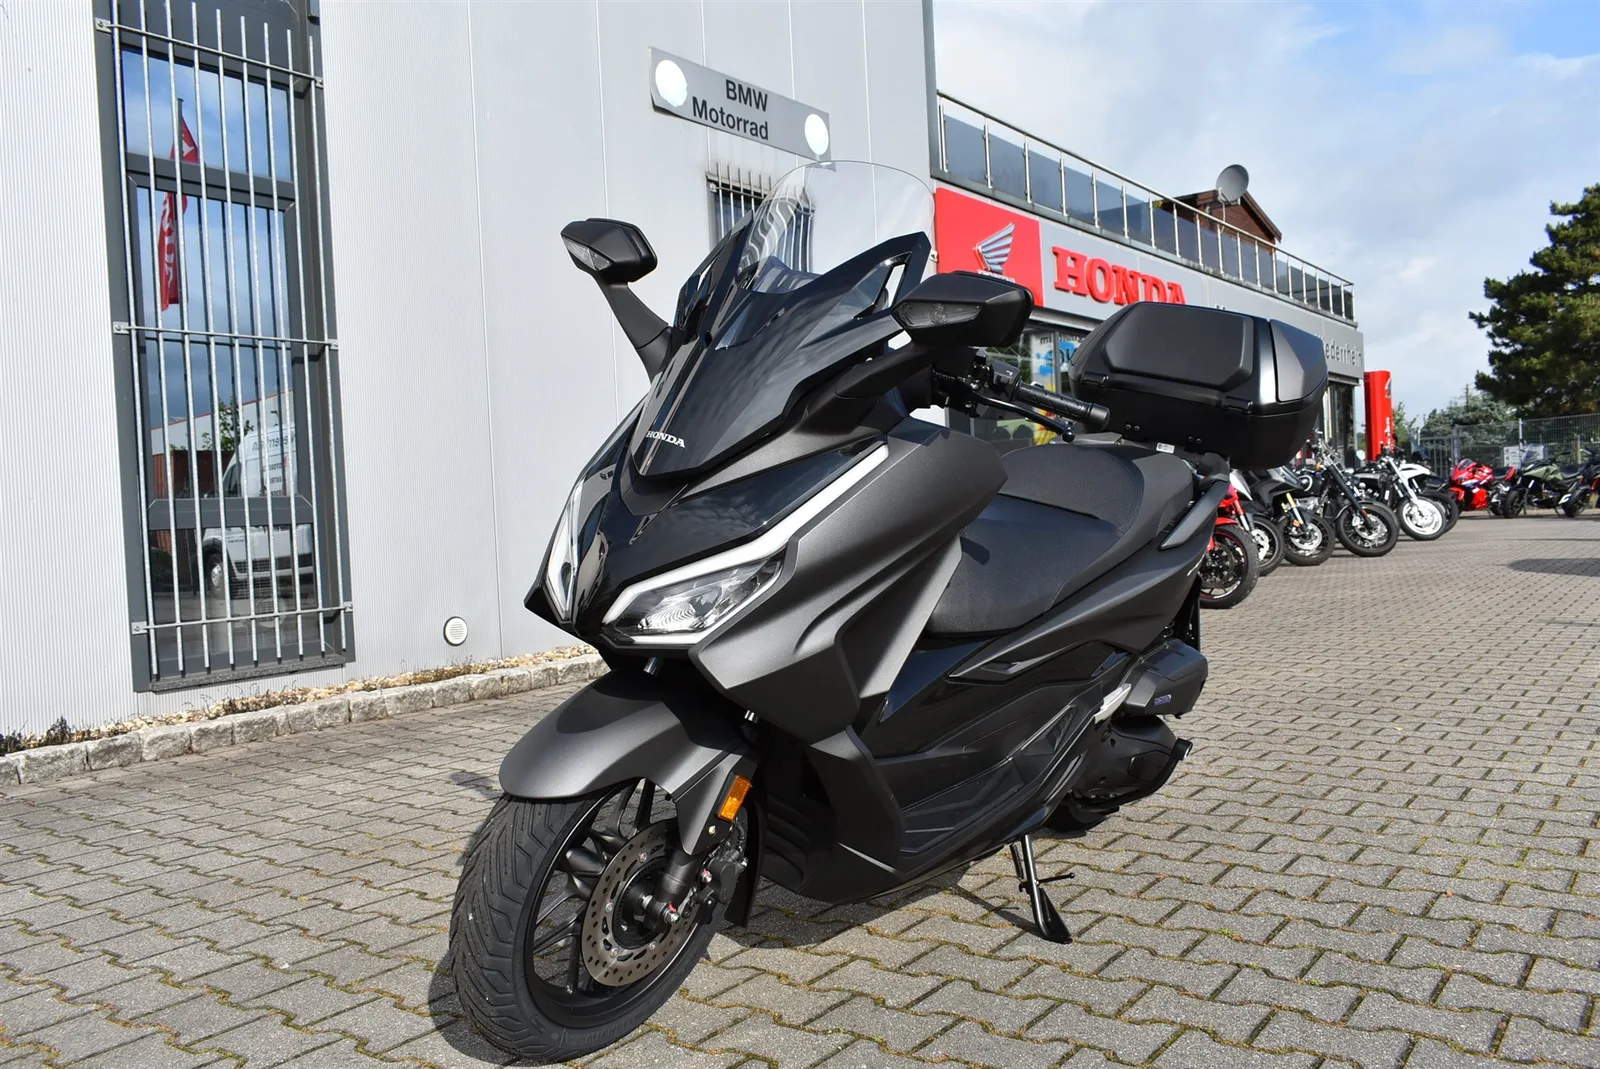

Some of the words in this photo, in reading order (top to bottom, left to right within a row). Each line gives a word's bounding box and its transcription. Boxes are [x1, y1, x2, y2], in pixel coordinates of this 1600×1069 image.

[725, 79, 768, 112] BMW
[692, 96, 769, 141] Motorrad
[1052, 246, 1187, 306] HONDA
[1325, 339, 1363, 368] ederrhein
[646, 430, 686, 448] HONDA
